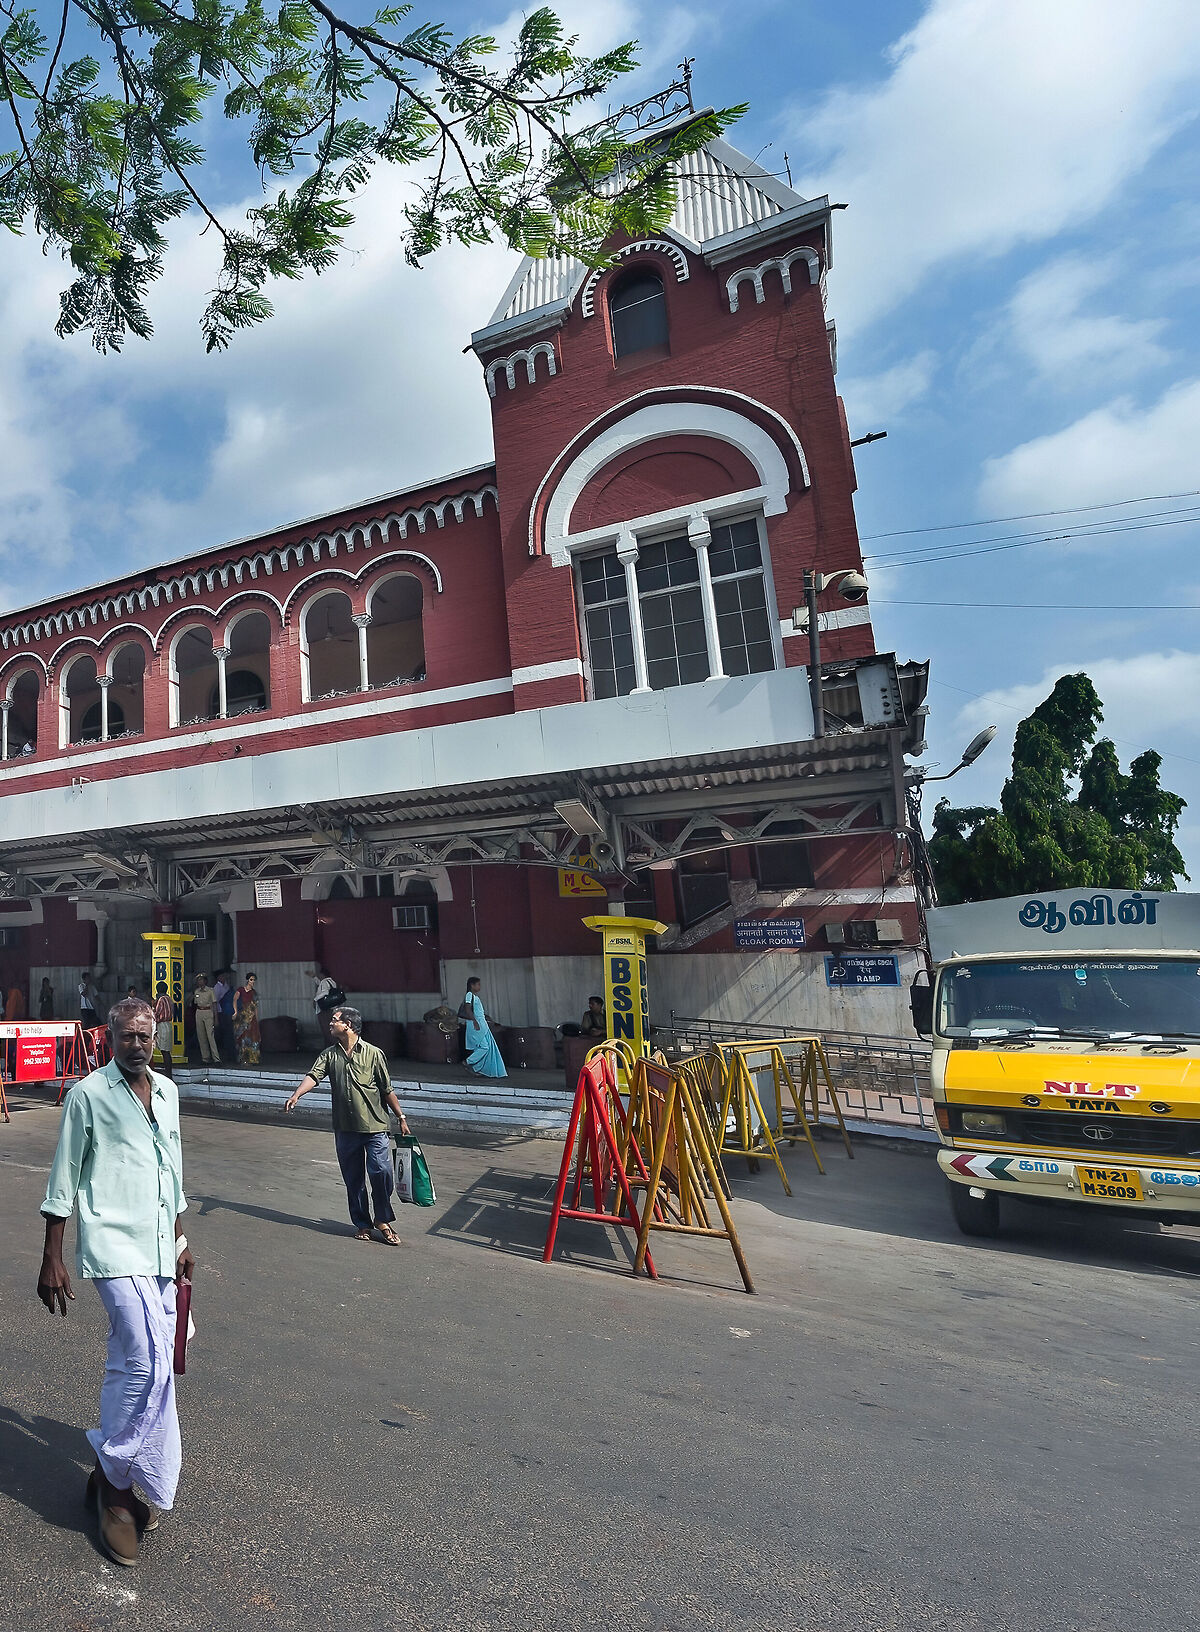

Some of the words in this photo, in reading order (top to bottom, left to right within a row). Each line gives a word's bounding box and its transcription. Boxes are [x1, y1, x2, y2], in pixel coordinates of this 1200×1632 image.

[1018, 892, 1160, 934] ஆவின்
[172, 961, 183, 1045] BSNL
[6, 1026, 23, 1036] Hapy
[24, 1026, 30, 1034] to
[30, 1026, 43, 1035] help
[1043, 1080, 1140, 1099] NLT
[1065, 1099, 1123, 1112] TATA
[1018, 1160, 1060, 1174] காம
[1084, 1168, 1129, 1183] TN-21
[1084, 1183, 1137, 1199] M-3609
